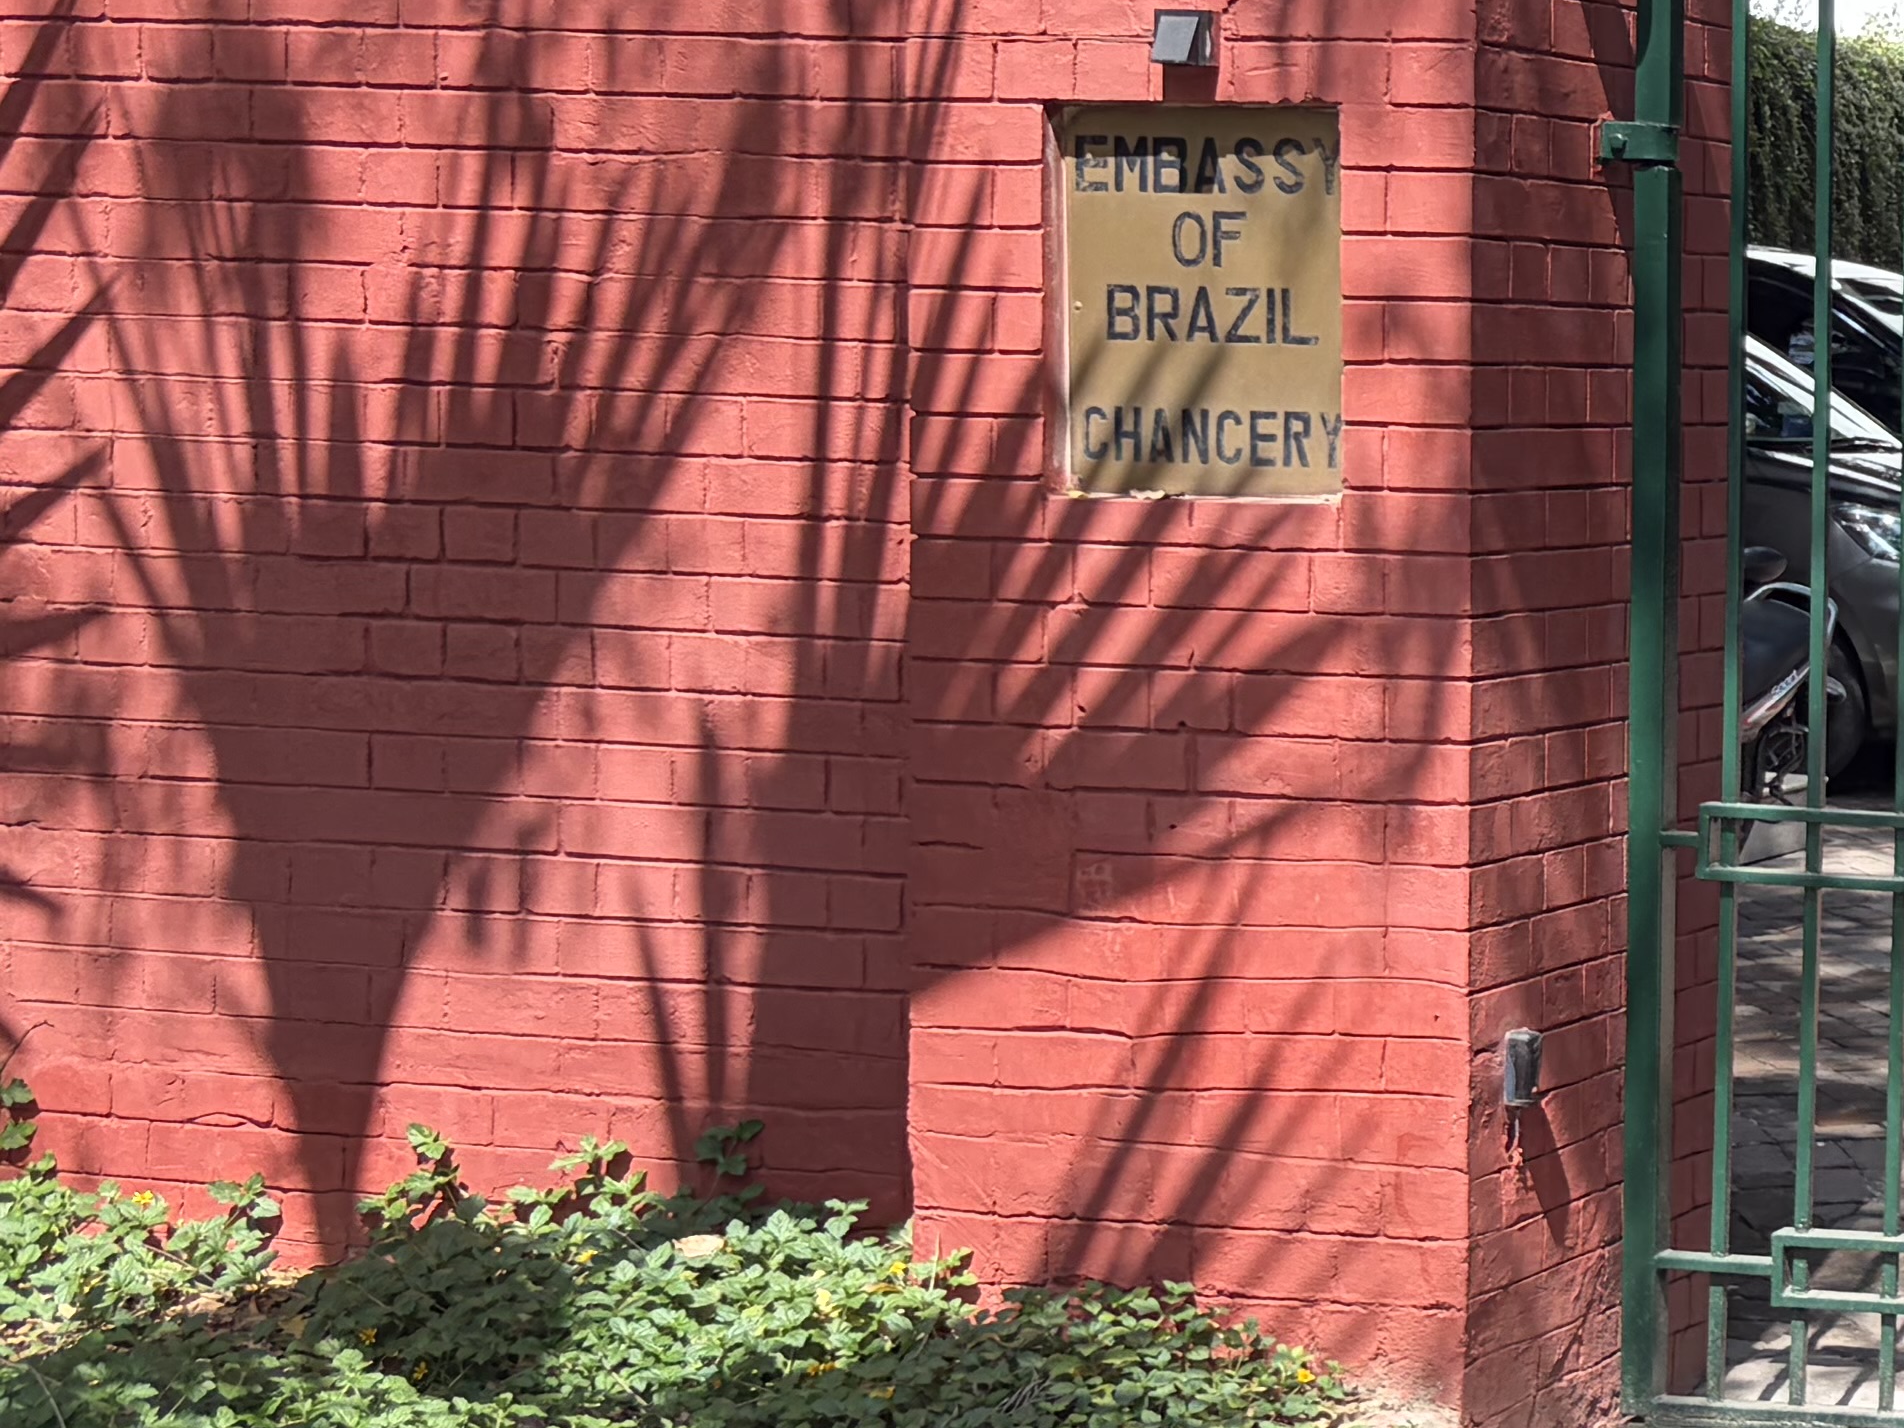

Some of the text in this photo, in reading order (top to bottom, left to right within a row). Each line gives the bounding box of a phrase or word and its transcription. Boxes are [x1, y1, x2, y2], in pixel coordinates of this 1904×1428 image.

[1075, 135, 1340, 195] EMBASSY
[1172, 210, 1247, 268] OF
[1106, 283, 1320, 345] BRAZIL
[1083, 405, 1341, 468] CHANCERY
